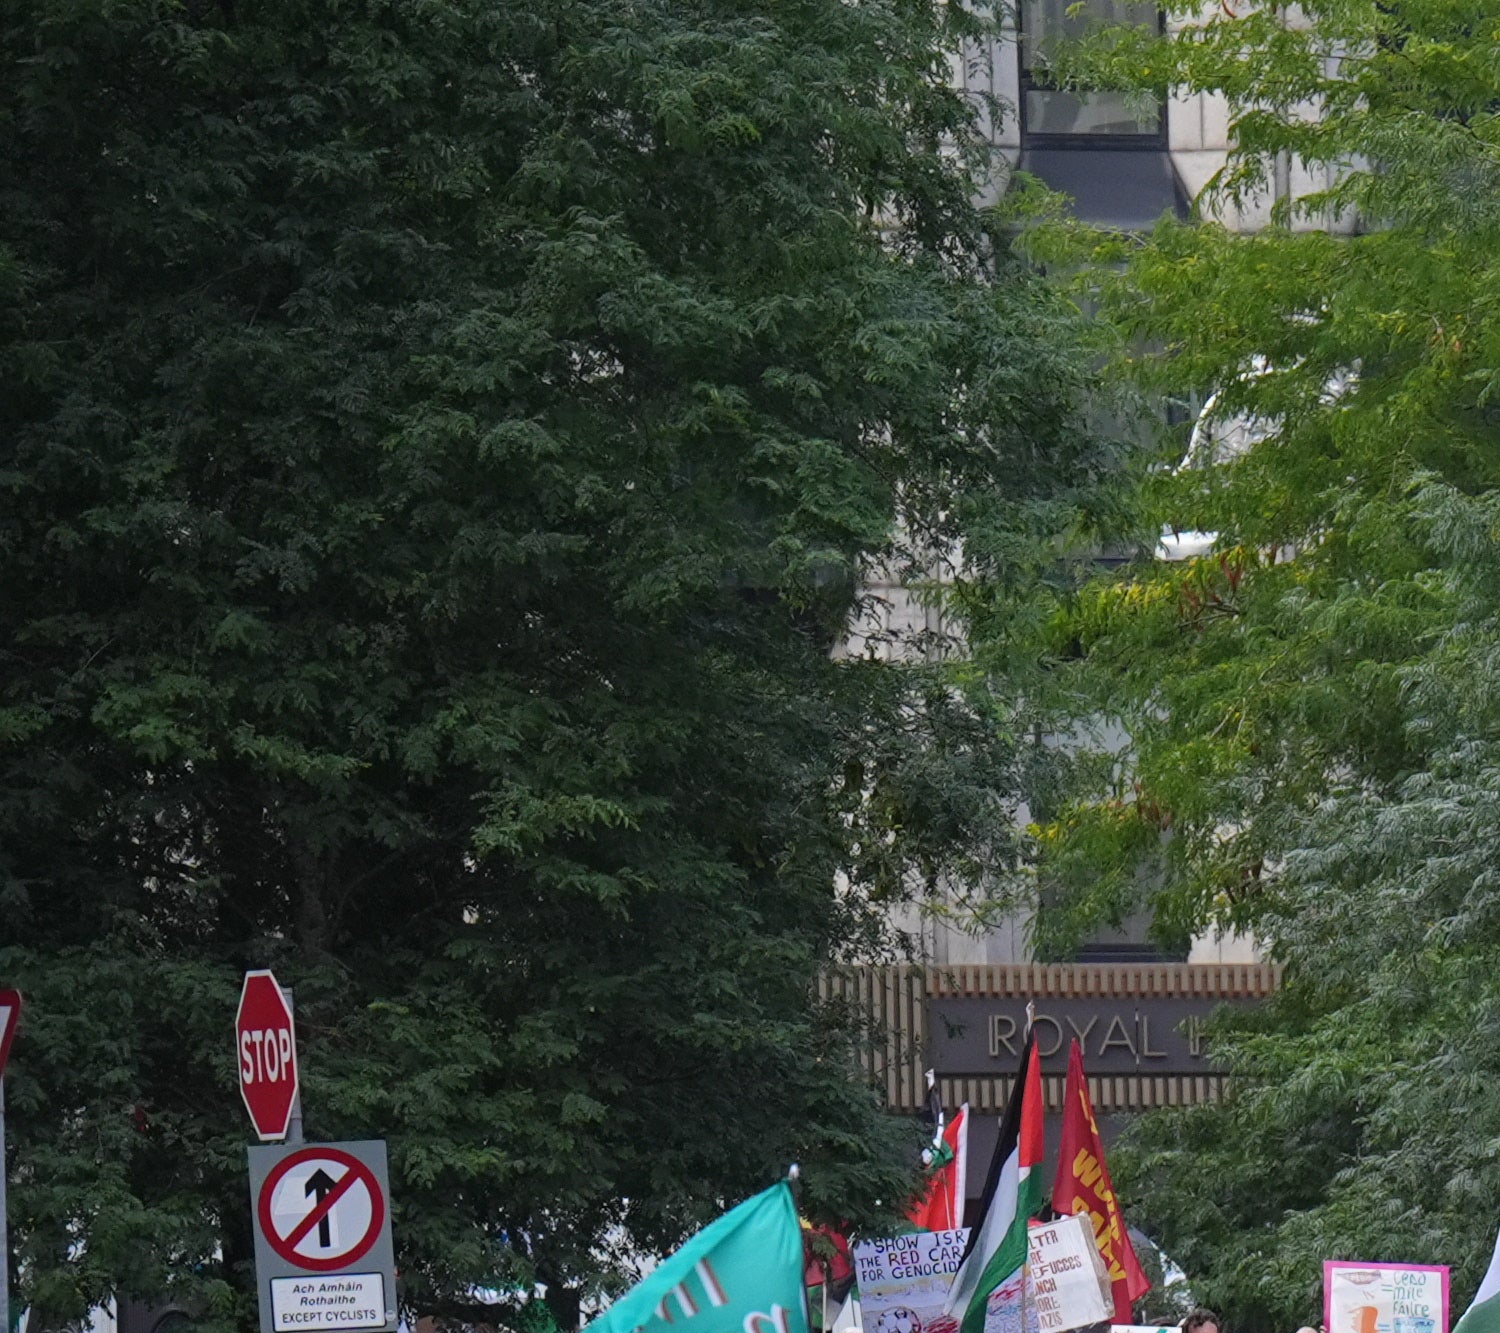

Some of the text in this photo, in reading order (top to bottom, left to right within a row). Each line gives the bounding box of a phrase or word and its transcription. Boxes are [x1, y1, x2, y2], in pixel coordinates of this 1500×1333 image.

[988, 1014, 1168, 1057] ROYAL
[241, 1028, 291, 1084] STOP
[859, 1256, 882, 1270] THE
[888, 1251, 920, 1267] RED
[862, 1269, 885, 1283] FOR
[293, 1281, 363, 1295] Ach Amháin
[300, 1294, 356, 1307] Rothaithe
[282, 1309, 376, 1324] EXCEPT CYCLISTS
